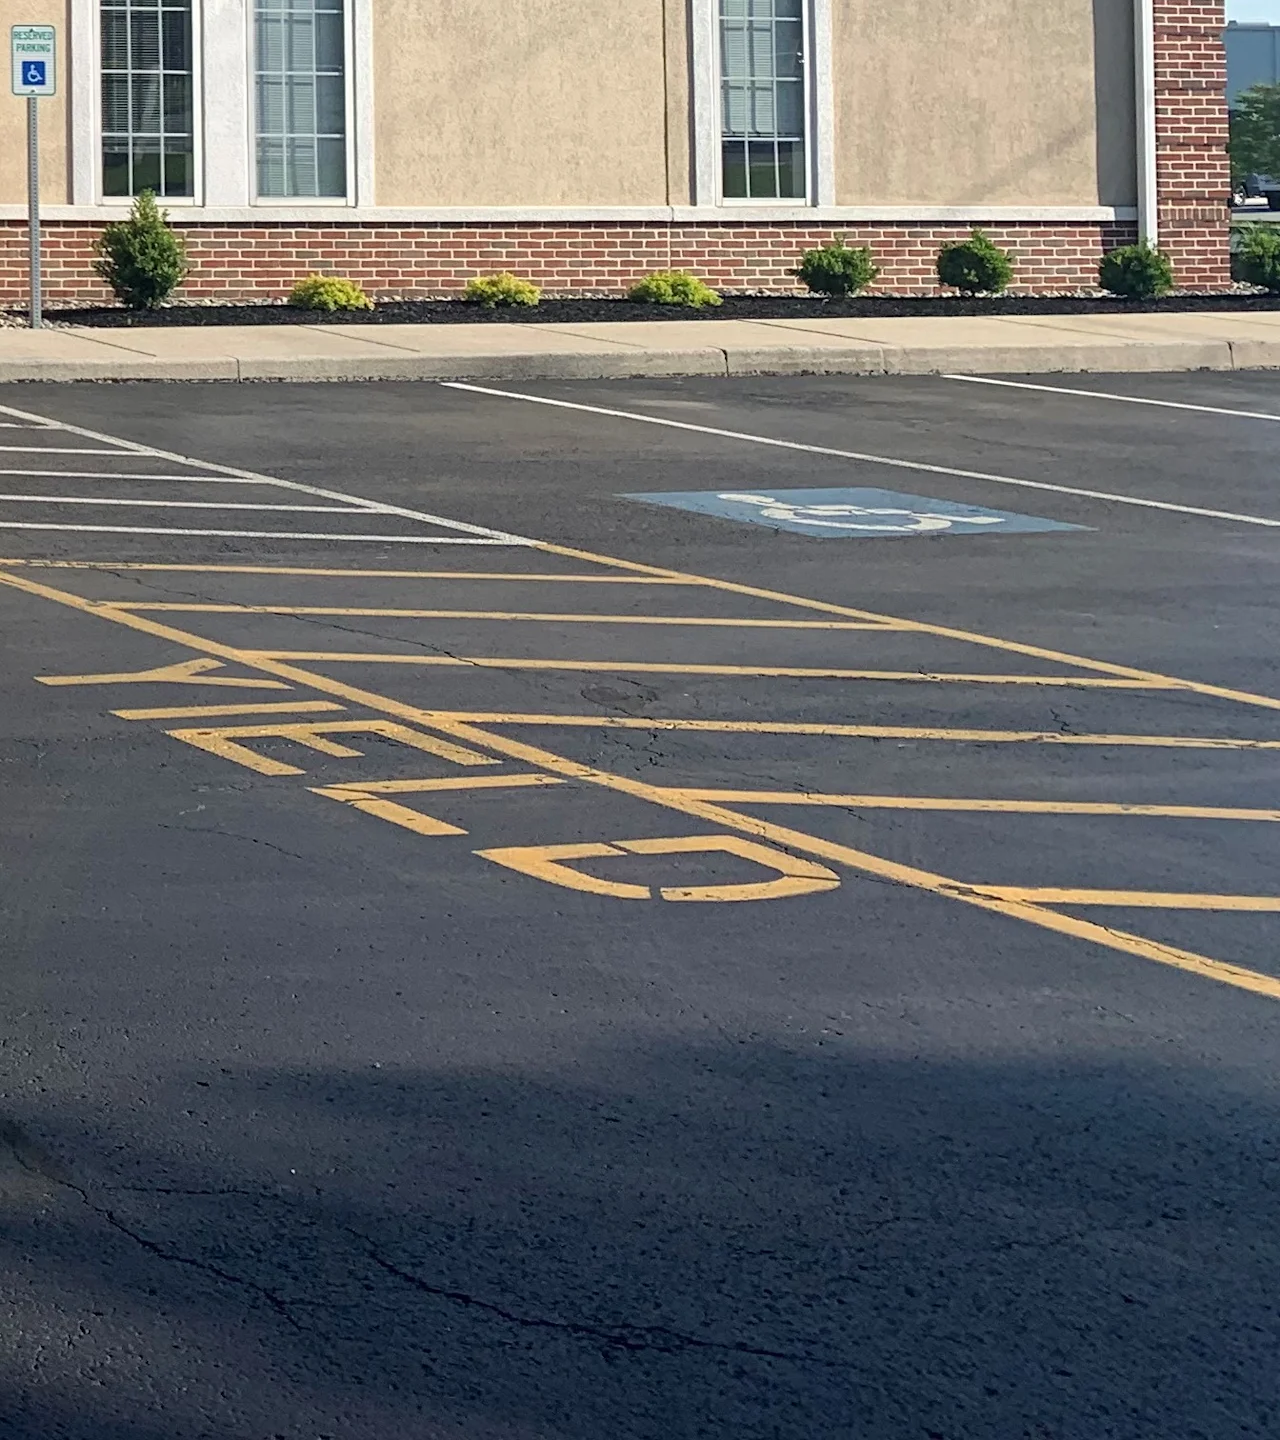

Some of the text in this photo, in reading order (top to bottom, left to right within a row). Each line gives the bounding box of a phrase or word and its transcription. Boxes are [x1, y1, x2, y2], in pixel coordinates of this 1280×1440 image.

[13, 31, 53, 40] RESERVED
[16, 43, 51, 52] PARKING
[33, 657, 842, 903] YIELD
